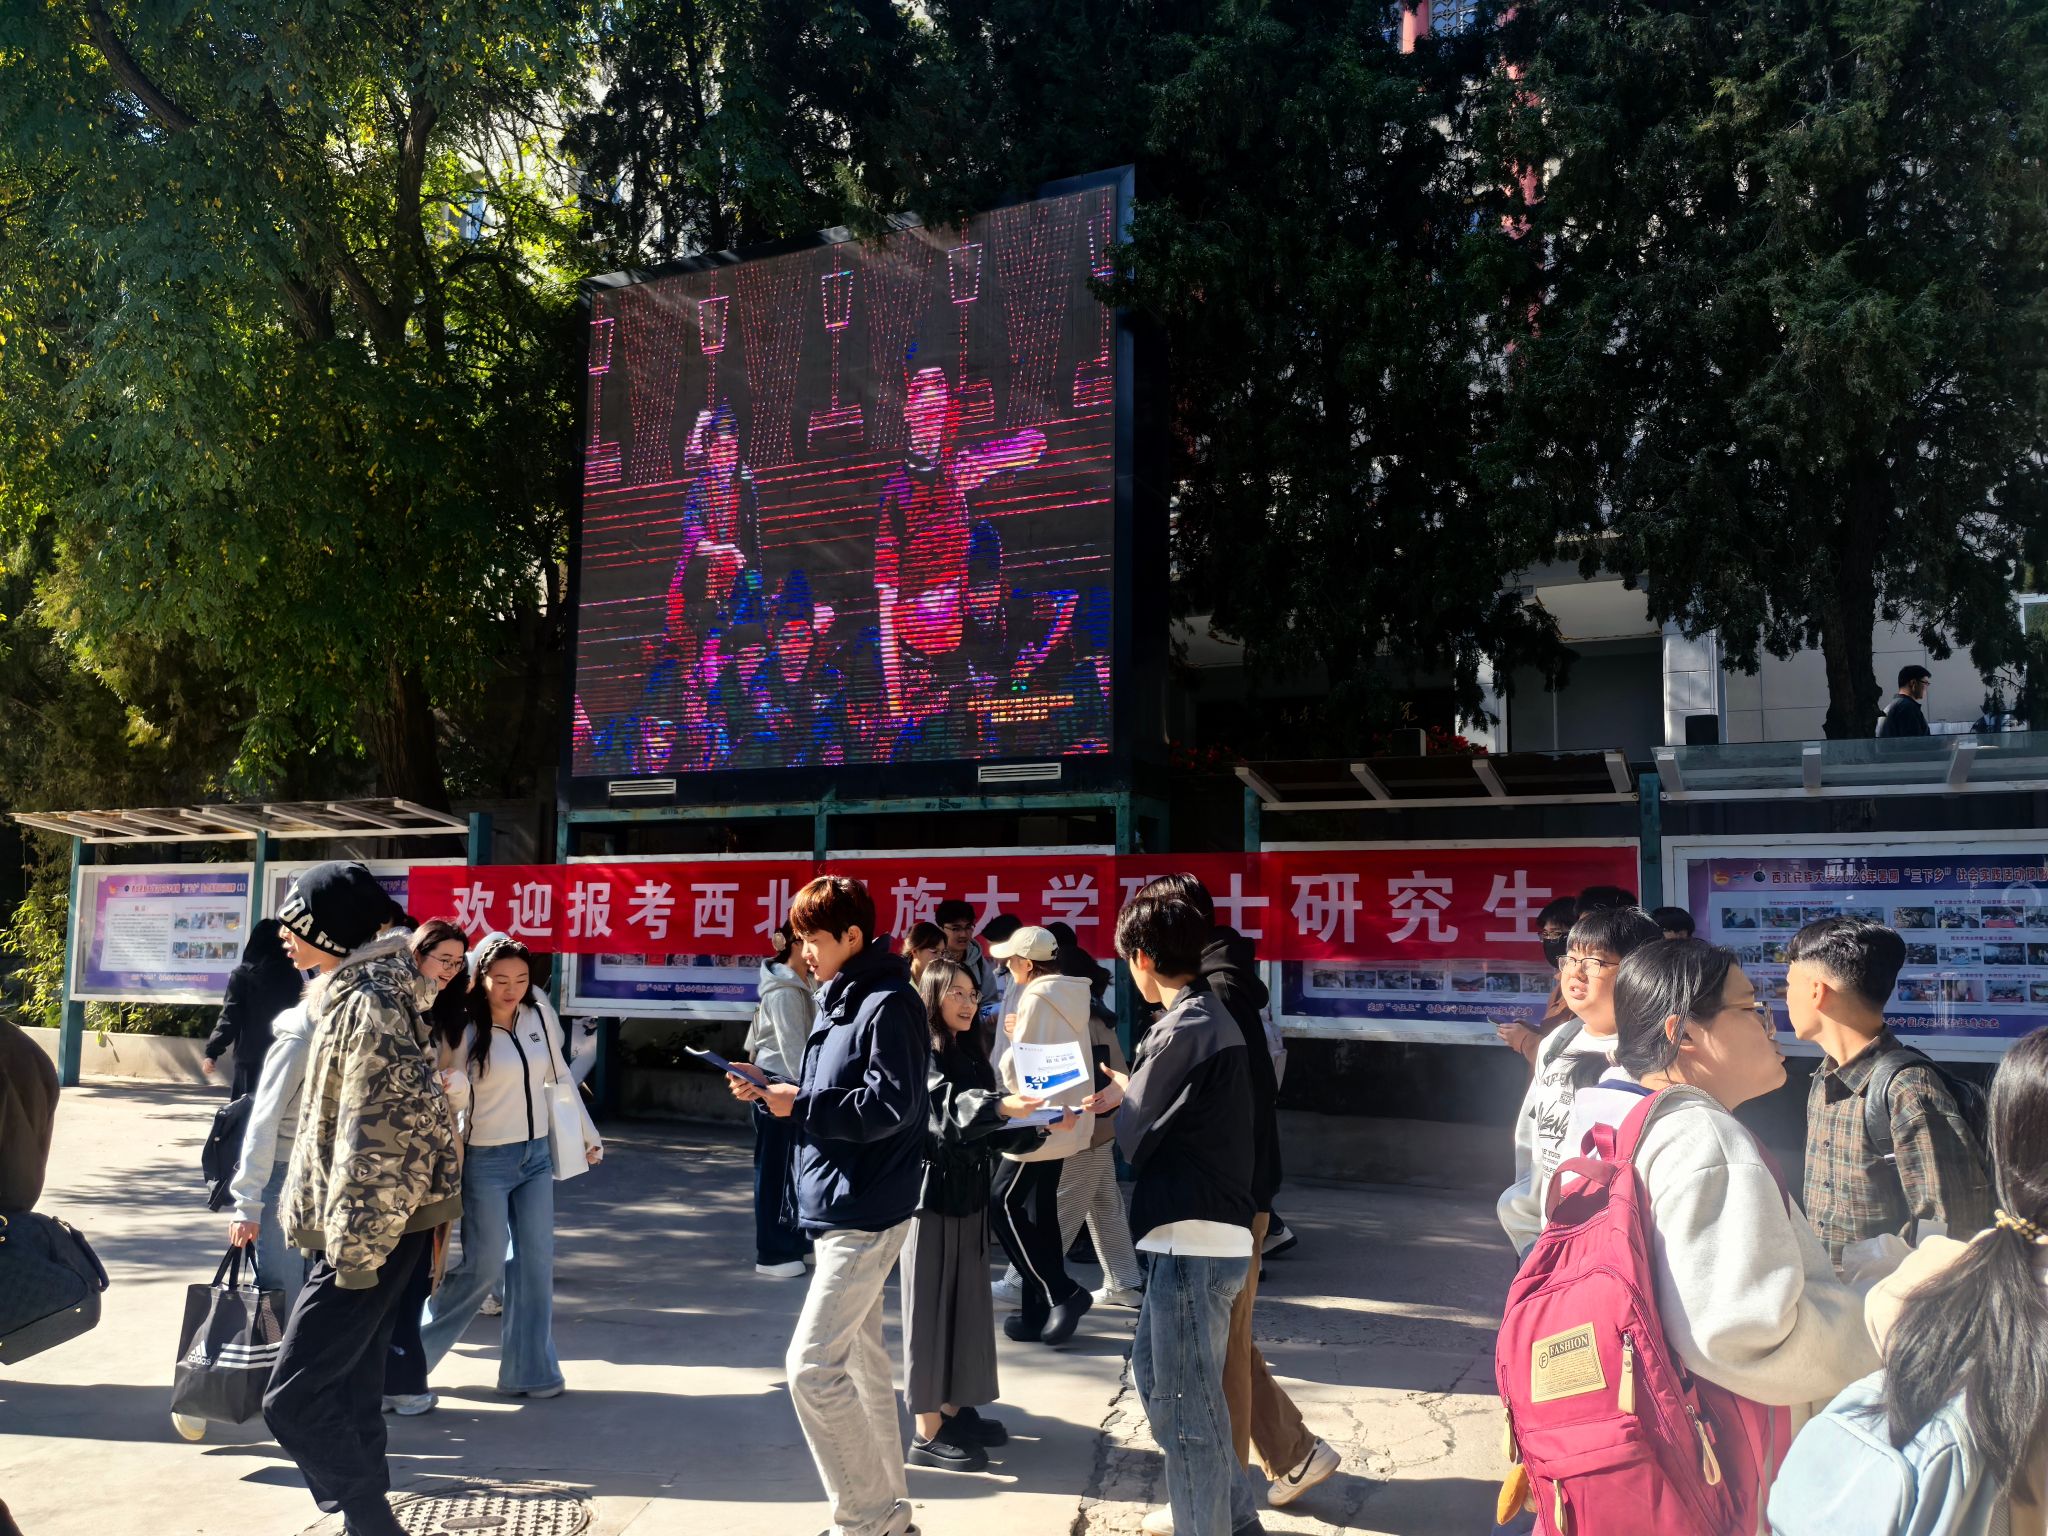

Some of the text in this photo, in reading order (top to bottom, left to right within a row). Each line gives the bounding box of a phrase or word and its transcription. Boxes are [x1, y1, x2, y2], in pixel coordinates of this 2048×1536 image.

[452, 869, 1553, 944] 欢迎报考西北族大学士研究生
[1032, 1075, 1049, 1083] 20
[1549, 1334, 1589, 1357] FASHION
[187, 1353, 212, 1365] adidas
